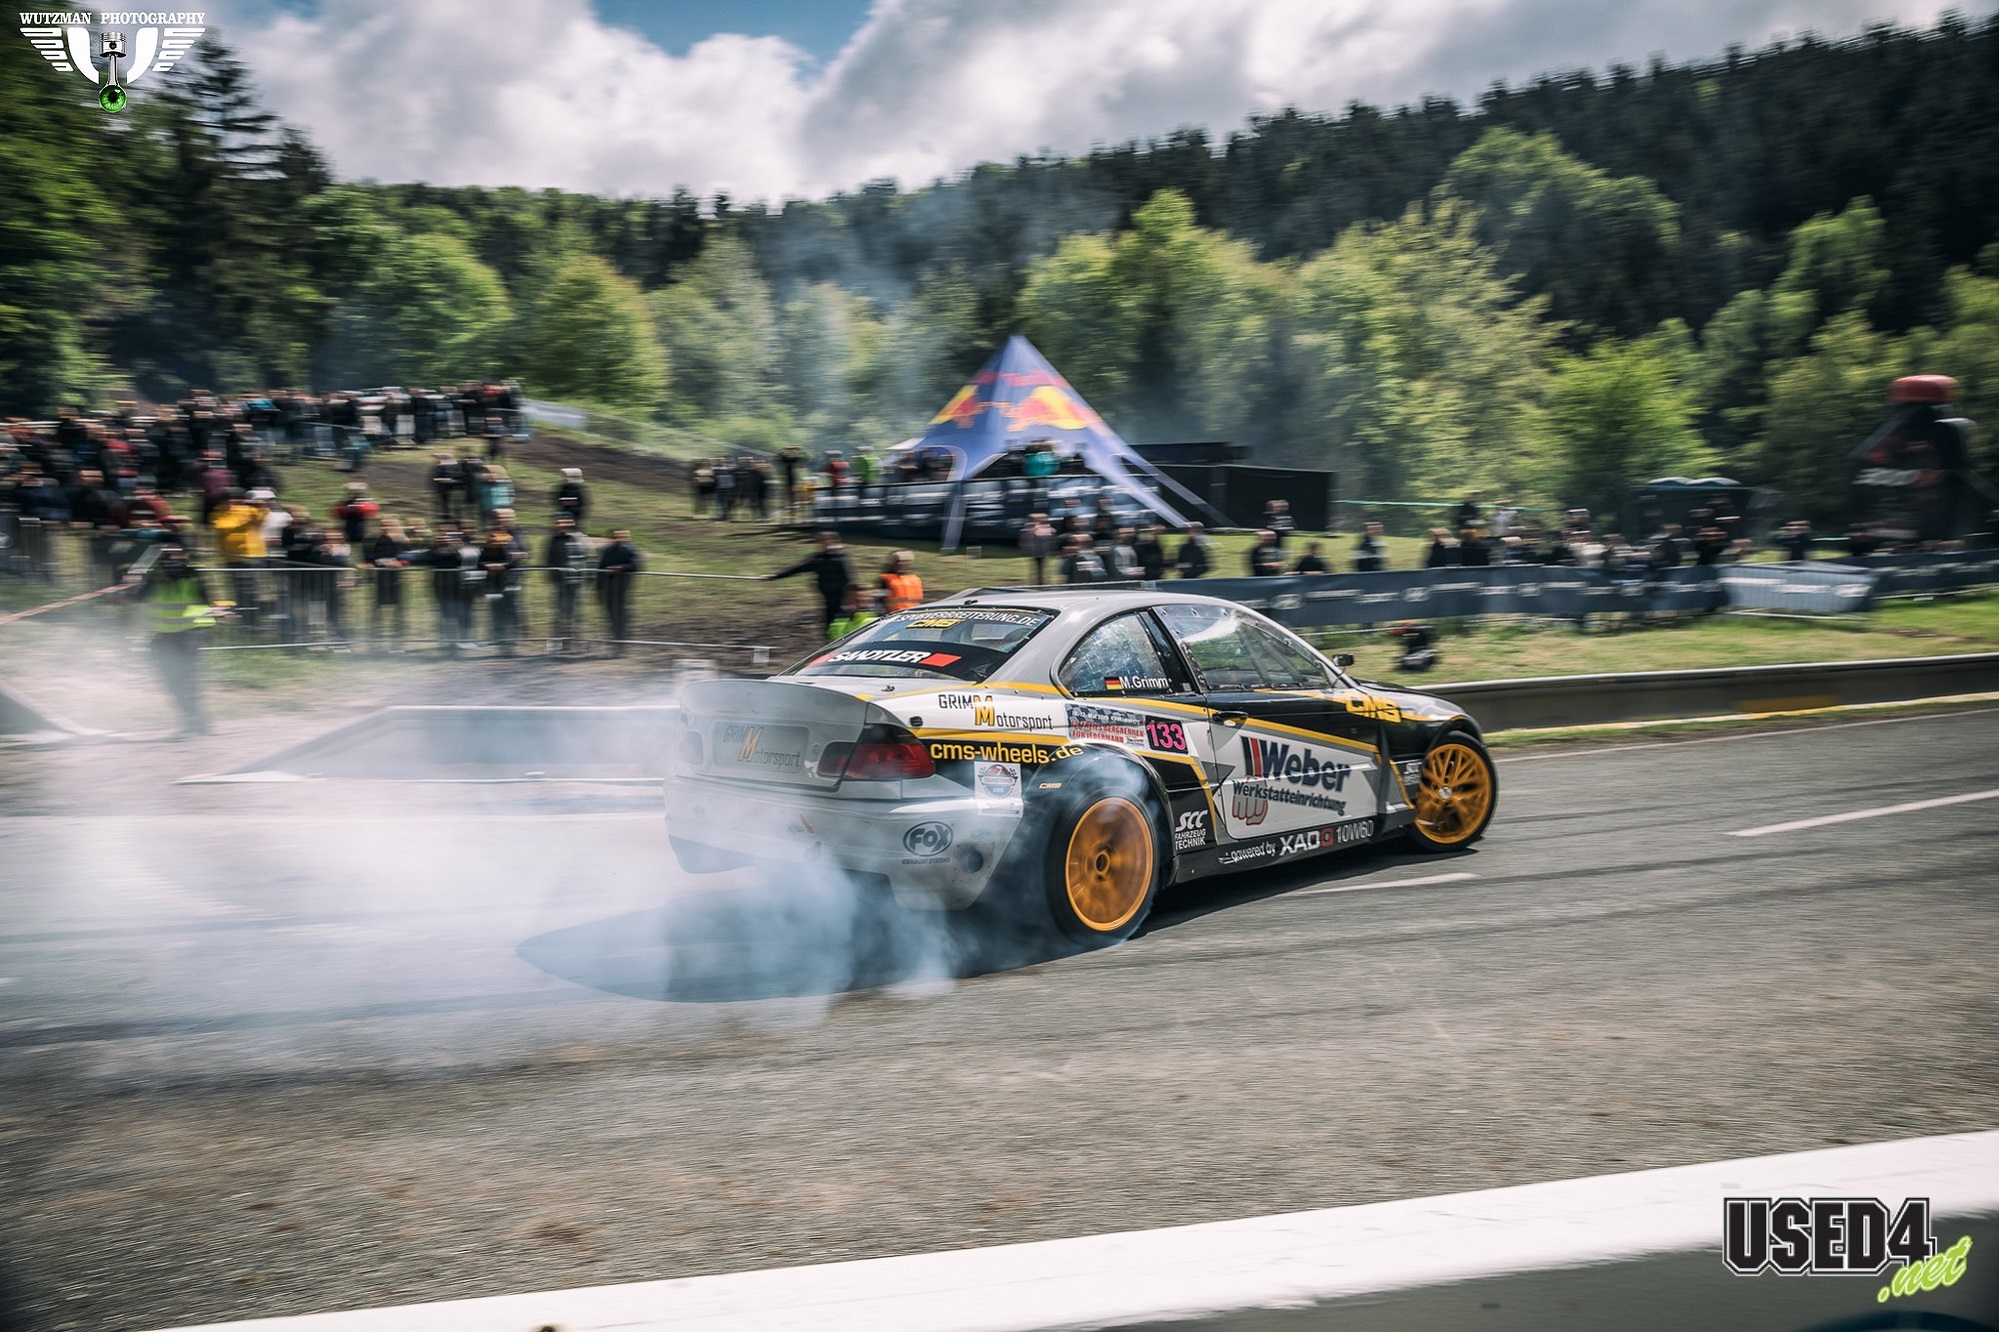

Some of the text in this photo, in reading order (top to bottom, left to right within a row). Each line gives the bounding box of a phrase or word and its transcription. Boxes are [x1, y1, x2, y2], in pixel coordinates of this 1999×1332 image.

[829, 649, 931, 664] SANDTLER
[1120, 676, 1169, 689] M.Grimm
[1147, 720, 1186, 750] 133
[930, 742, 1084, 764] cms-wheels.de
[1259, 740, 1352, 792] Weber
[1233, 781, 1347, 816] Werkstatteinrichtung
[1175, 810, 1208, 832] SCC
[909, 825, 949, 853] FOX
[1175, 829, 1206, 841] FAHRZEUG
[1175, 836, 1206, 850] TECHNIK
[1231, 840, 1267, 863] powered
[1266, 841, 1276, 857] by
